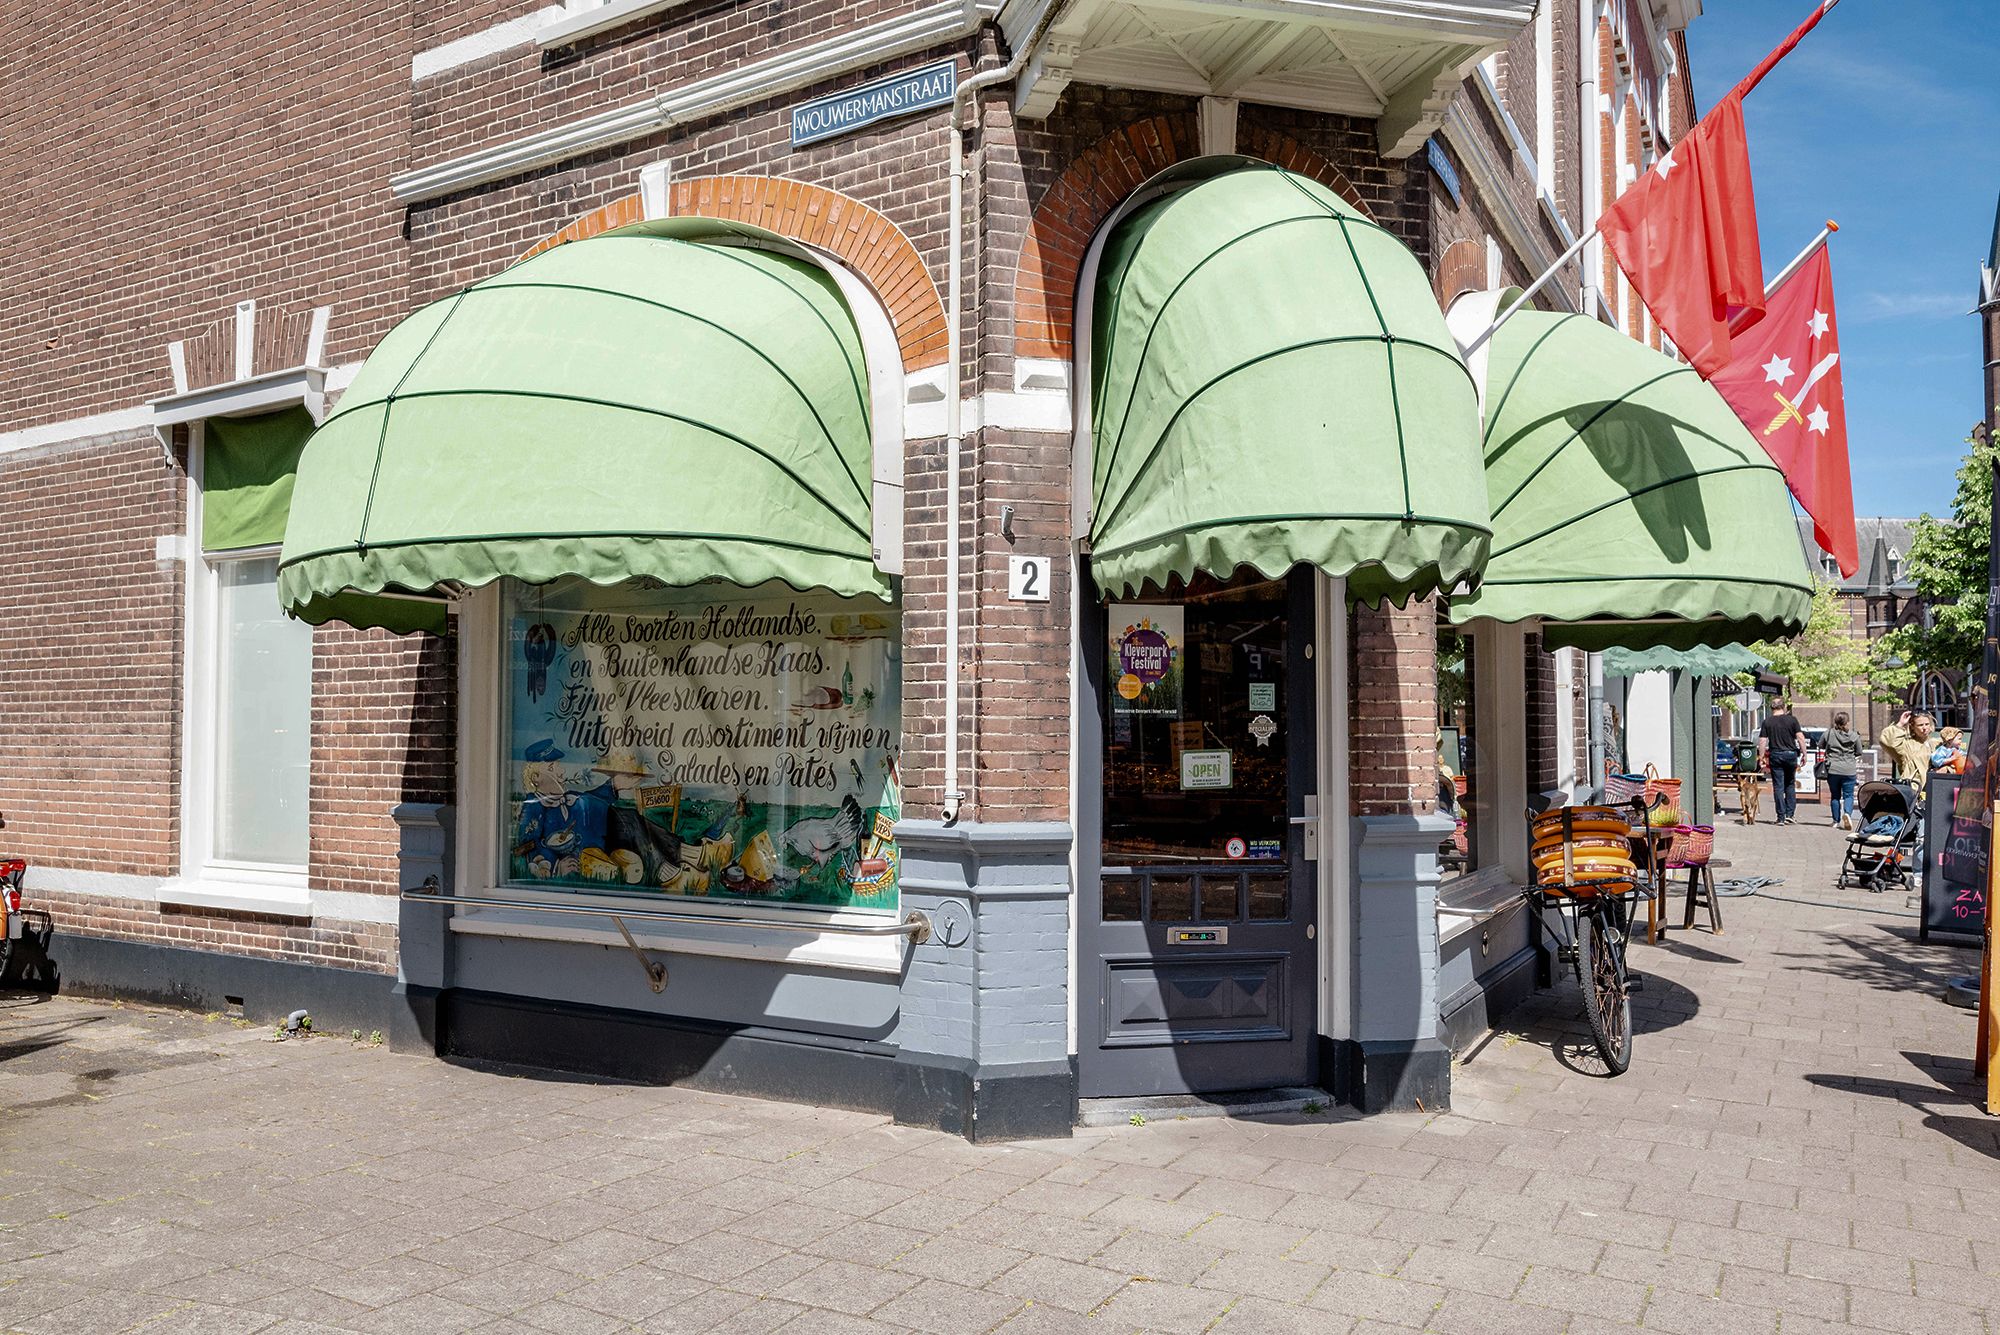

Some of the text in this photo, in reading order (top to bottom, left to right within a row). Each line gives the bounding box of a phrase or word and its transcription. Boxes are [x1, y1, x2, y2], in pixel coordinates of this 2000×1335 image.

[797, 72, 950, 135] WOUWERMANSTRAAT
[1022, 561, 1038, 595] 2
[563, 609, 616, 651] Alle
[620, 609, 696, 643] Soorten
[570, 640, 830, 679] en Buitenlandse Kaas.
[1124, 643, 1168, 659] Kleverpark
[1131, 657, 1162, 669] Festival
[555, 679, 768, 720] Fijne Vleeswaren.
[564, 711, 899, 757] Uitgebreid assortiment wijnen,
[657, 750, 741, 788] Salades
[744, 764, 772, 786] en
[1192, 764, 1221, 778] OPEN
[1951, 904, 1987, 919] 10-1
